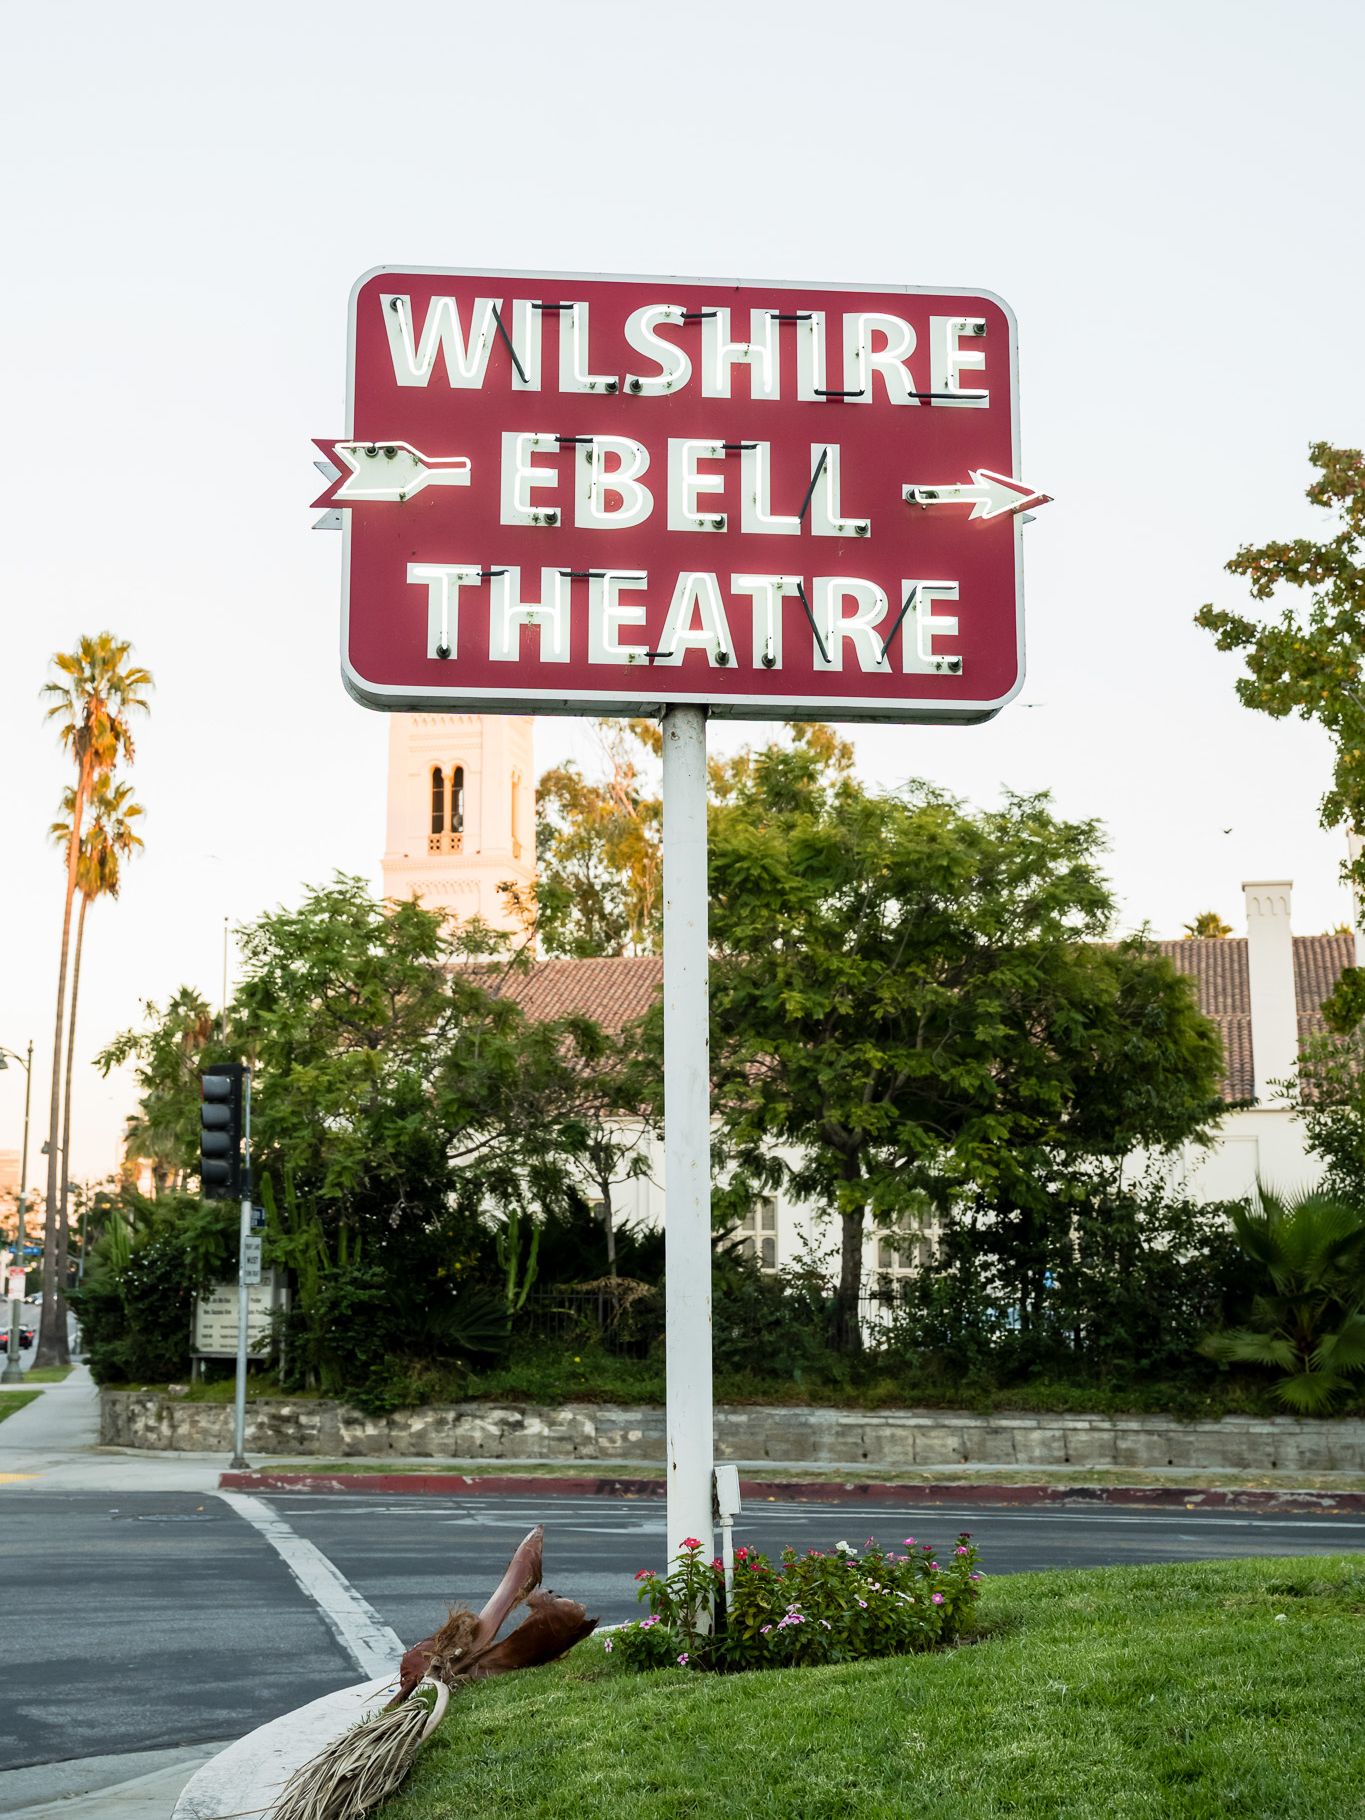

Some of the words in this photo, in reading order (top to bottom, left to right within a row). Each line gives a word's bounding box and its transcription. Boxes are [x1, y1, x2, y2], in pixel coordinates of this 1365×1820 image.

[379, 294, 990, 408] WILSHIRE
[500, 431, 871, 538] EBELL
[407, 563, 963, 675] THEATRE
